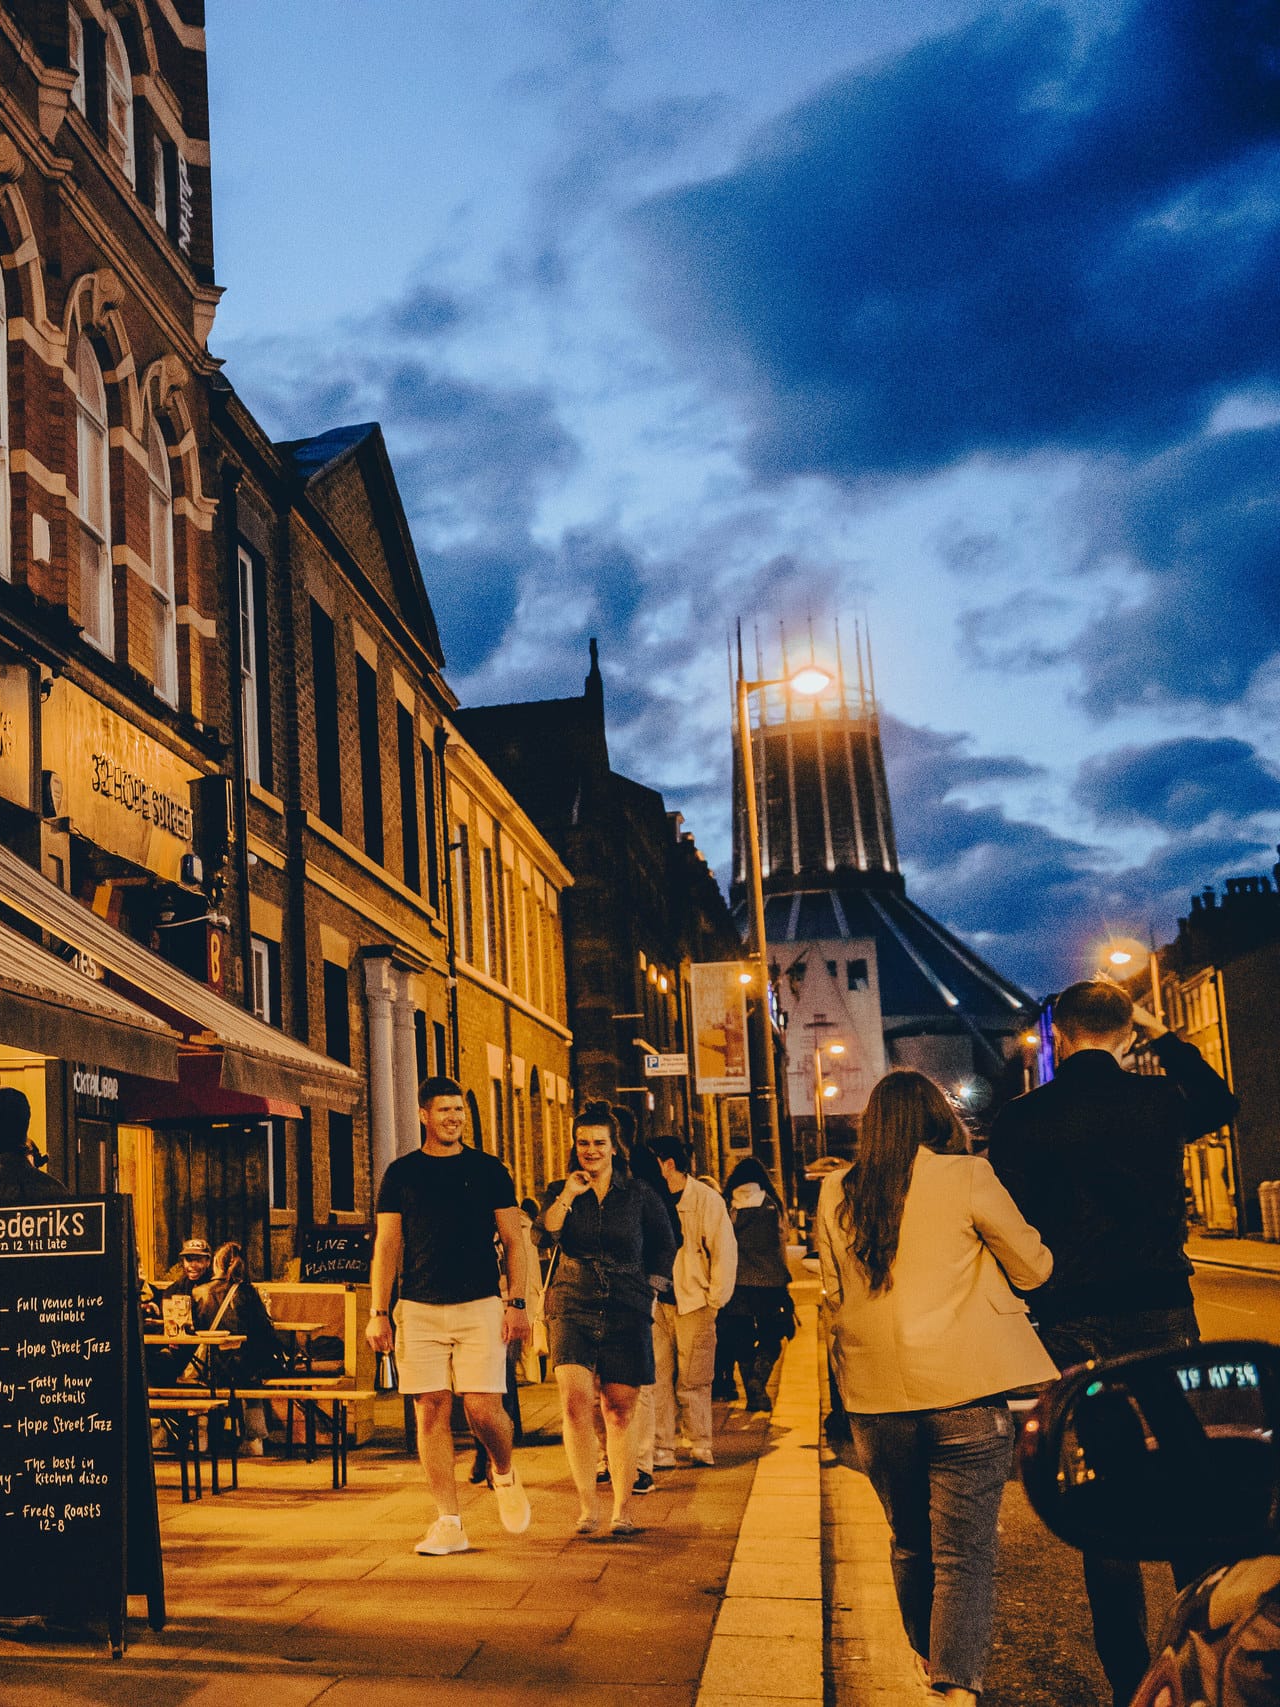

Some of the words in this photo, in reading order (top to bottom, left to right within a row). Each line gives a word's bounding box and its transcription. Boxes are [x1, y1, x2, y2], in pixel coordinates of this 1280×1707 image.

[13, 1241, 23, 1251] 12
[47, 1238, 67, 1250] late
[316, 1239, 348, 1253] LIVE
[17, 1297, 38, 1312] Full
[77, 1294, 104, 1308] hire
[39, 1310, 86, 1323] available
[16, 1339, 47, 1358] Hope
[50, 1338, 82, 1358] Street
[83, 1337, 112, 1361] Jazz
[63, 1374, 93, 1388] hour
[39, 1390, 86, 1405] cocktails
[17, 1416, 48, 1437] Hope
[52, 1415, 85, 1434] Street
[87, 1412, 113, 1433] Jazz
[24, 1457, 46, 1472] The
[52, 1455, 76, 1470] best
[81, 1457, 94, 1470] in
[78, 1471, 109, 1485] disco
[22, 1503, 55, 1519] Freds
[63, 1503, 101, 1521] Roasts
[39, 1519, 65, 1533] 12-8
